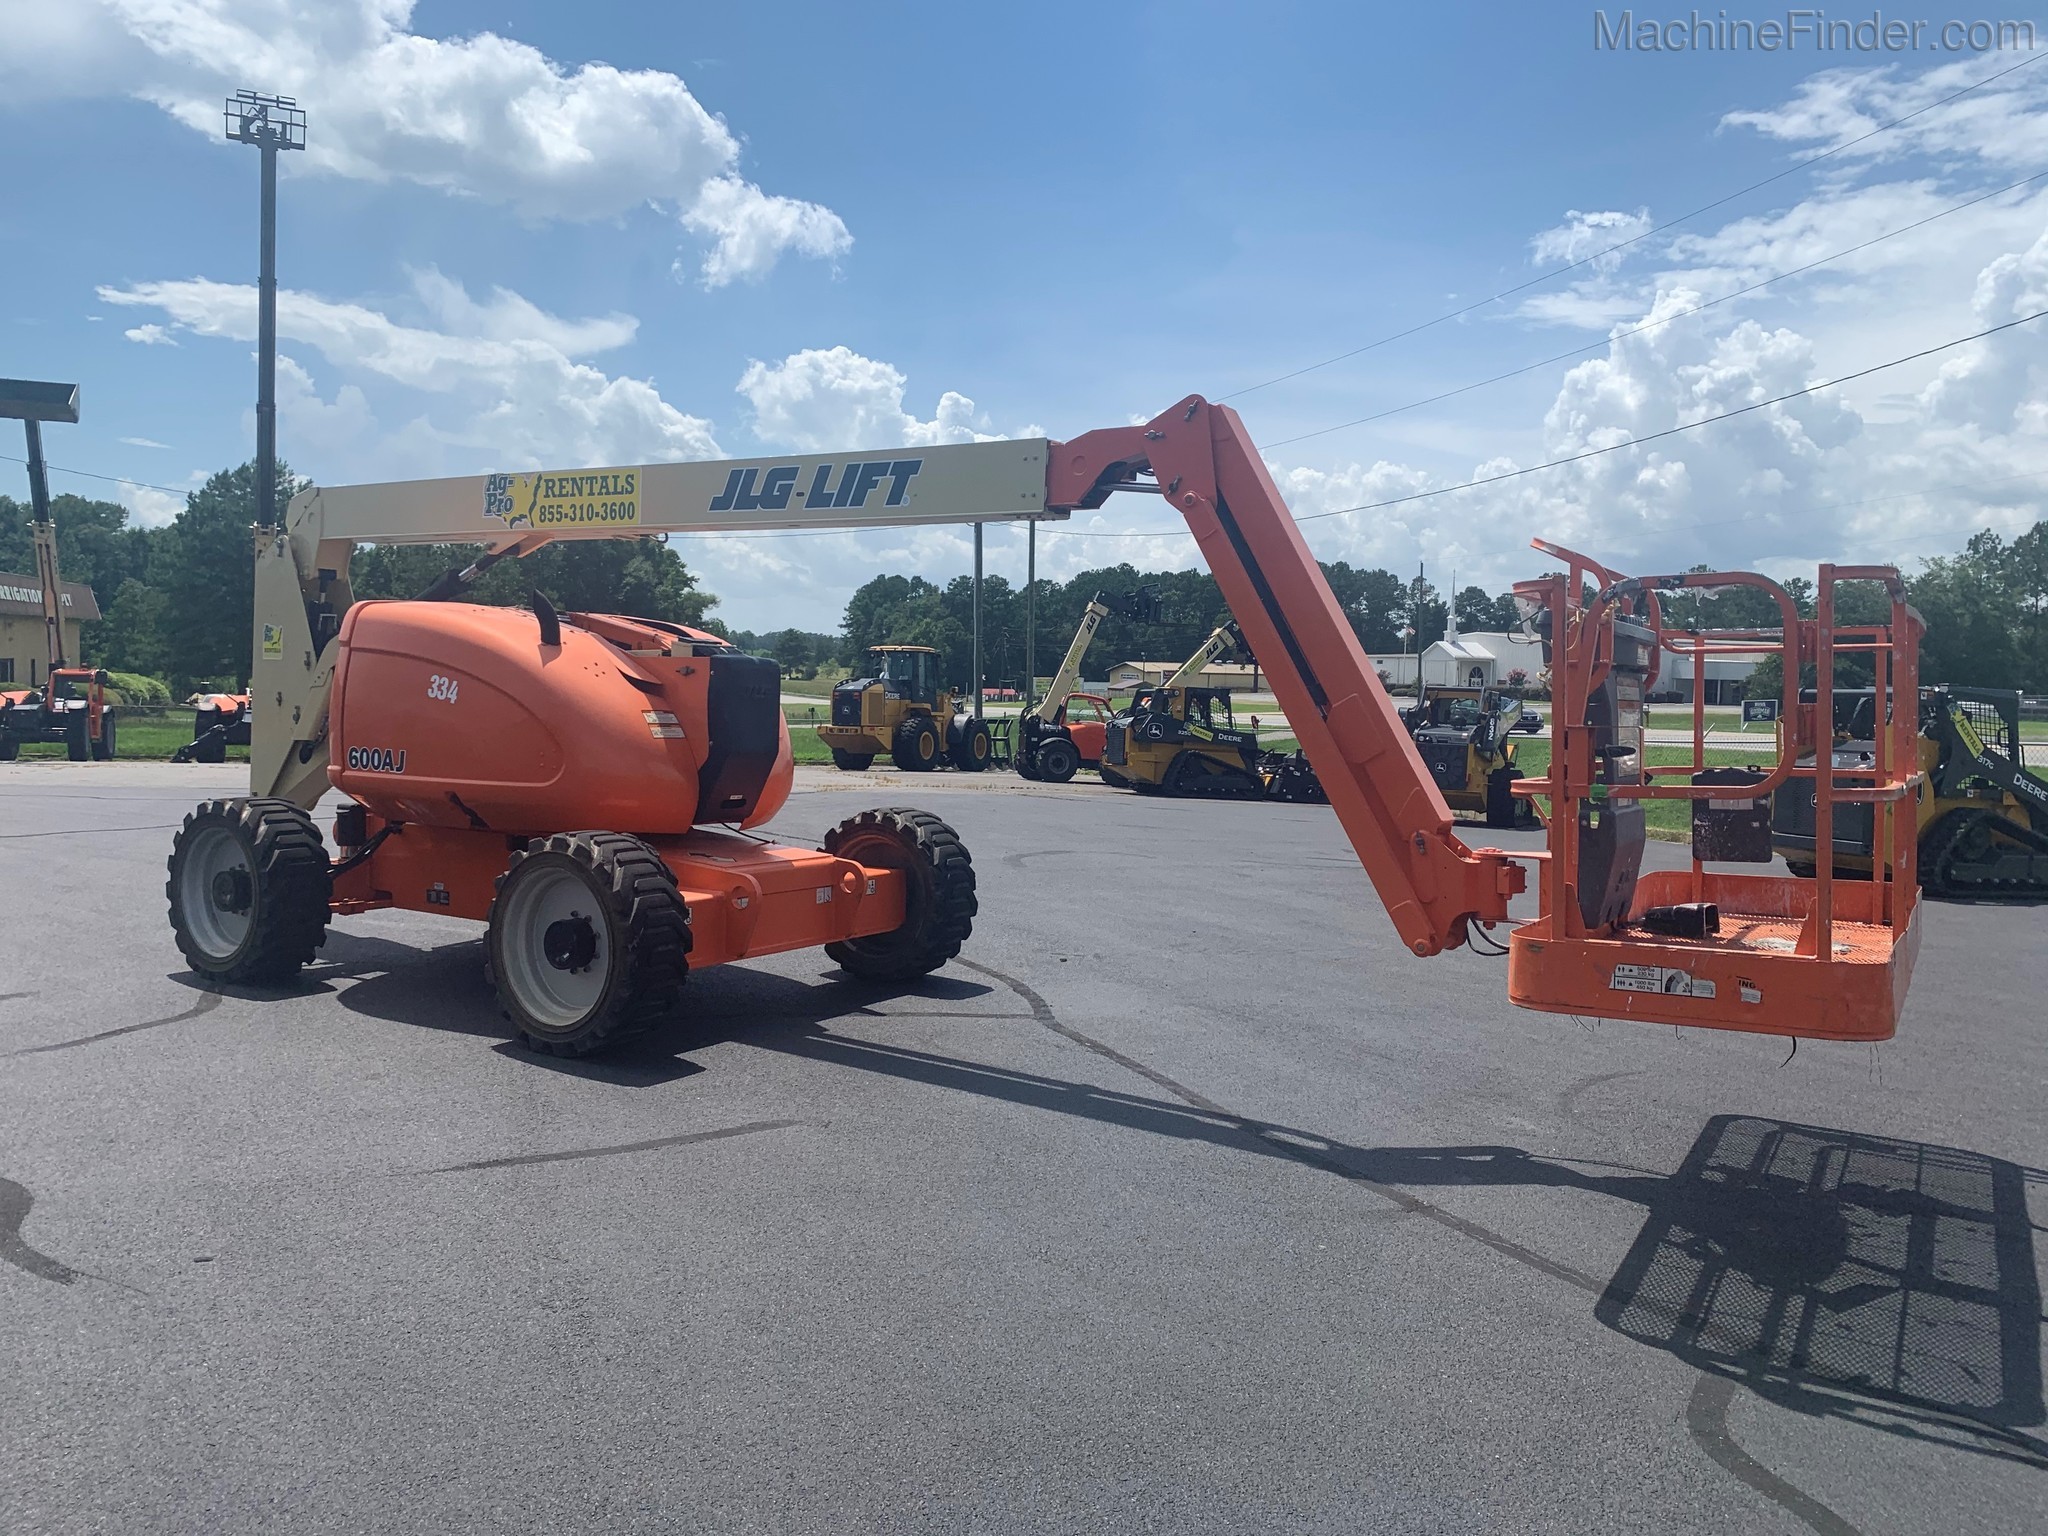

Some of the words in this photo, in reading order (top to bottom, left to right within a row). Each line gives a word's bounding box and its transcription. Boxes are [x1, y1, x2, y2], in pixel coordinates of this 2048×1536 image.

[543, 474, 635, 498] RENTALS
[484, 492, 514, 516] Pro
[539, 501, 635, 523] 855-310-3600
[1086, 615, 1096, 634] JLG
[1206, 642, 1219, 659] JLG
[427, 674, 458, 704] 334
[1218, 733, 1242, 742] DEERE
[348, 746, 406, 773] 600AJ
[1977, 755, 1995, 769] 317G
[2013, 773, 2048, 801] DEERE
